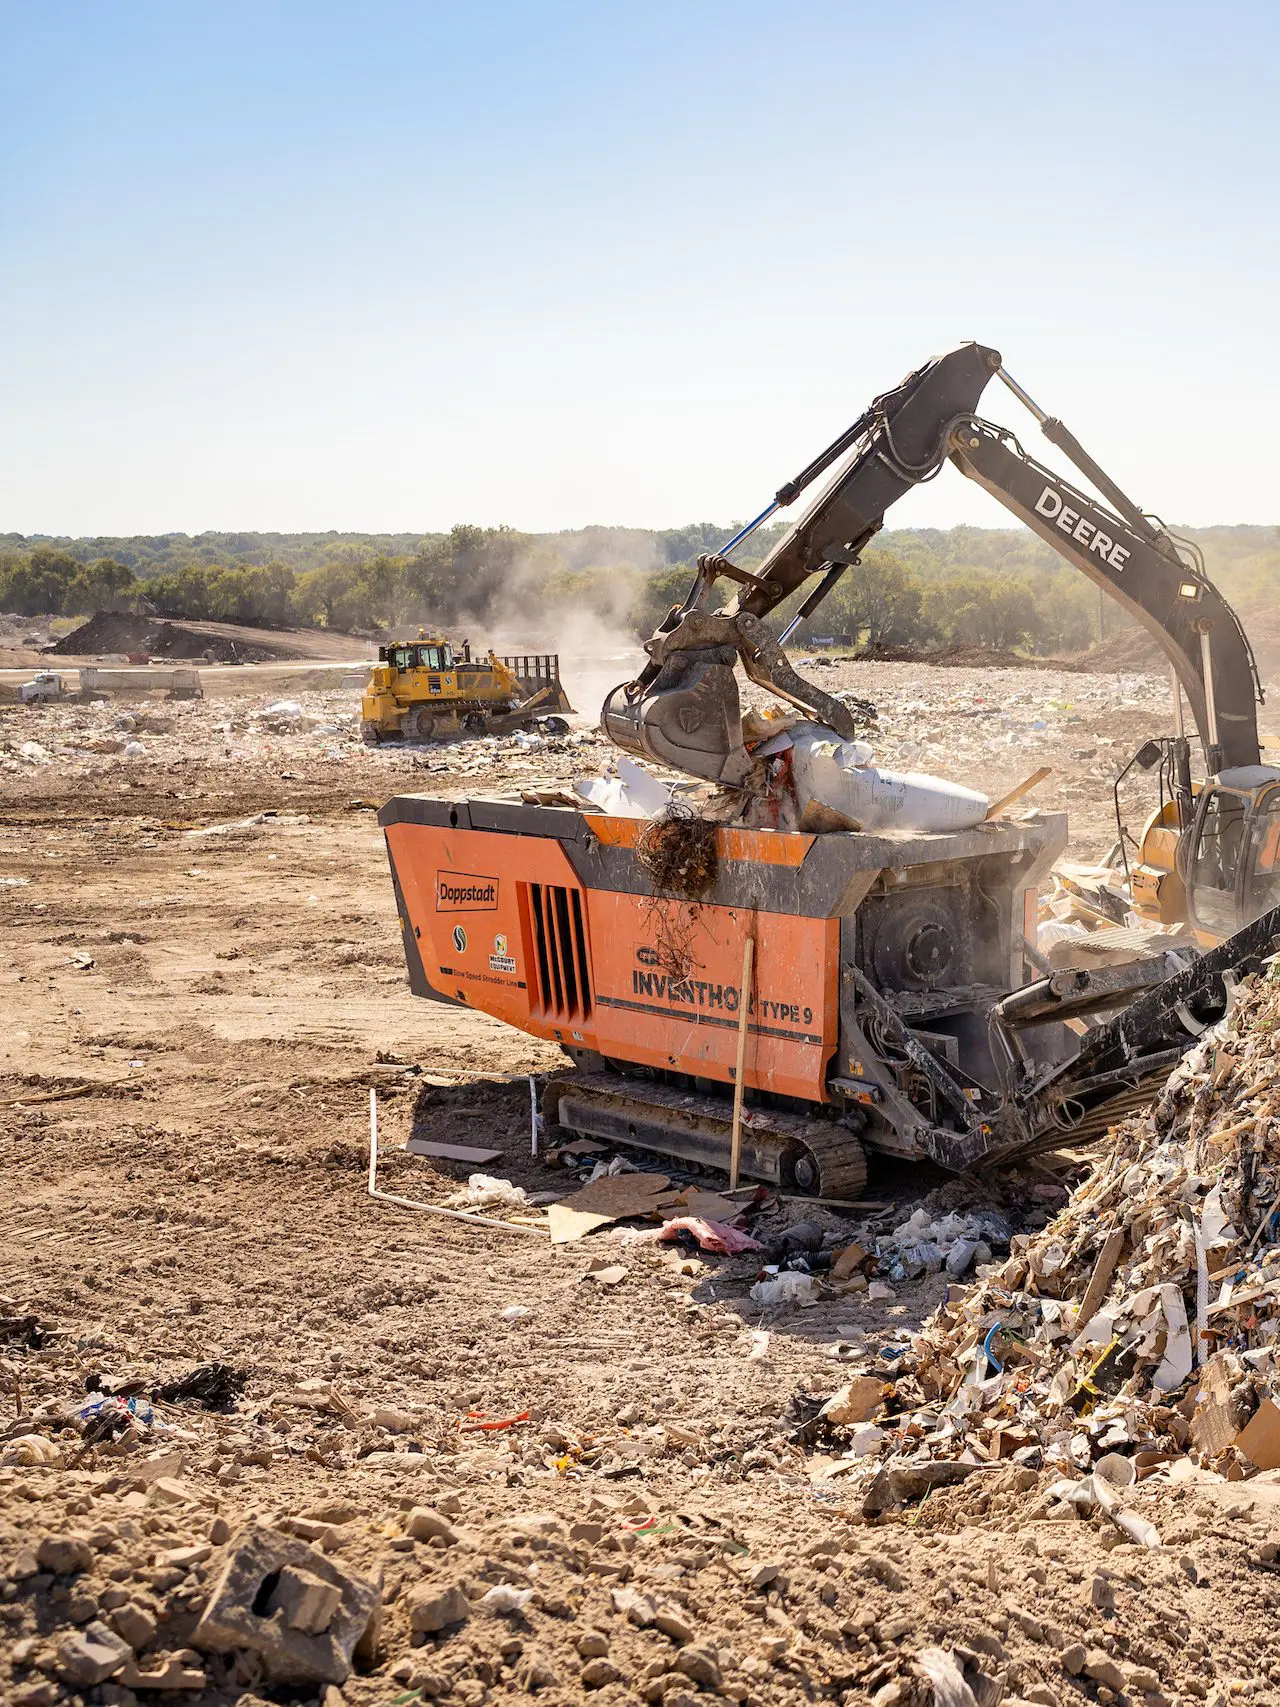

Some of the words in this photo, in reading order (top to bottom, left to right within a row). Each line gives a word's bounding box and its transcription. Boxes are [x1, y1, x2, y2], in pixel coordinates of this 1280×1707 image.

[1034, 486, 1131, 572] DEERE
[440, 883, 495, 904] Doppstadt
[489, 955, 515, 965] McCOURT
[490, 962, 515, 972] EQUIPMENT
[466, 971, 481, 981] Speed
[482, 974, 505, 985] Shredder
[760, 1000, 800, 1024] TYPE
[803, 1007, 813, 1025] 9
